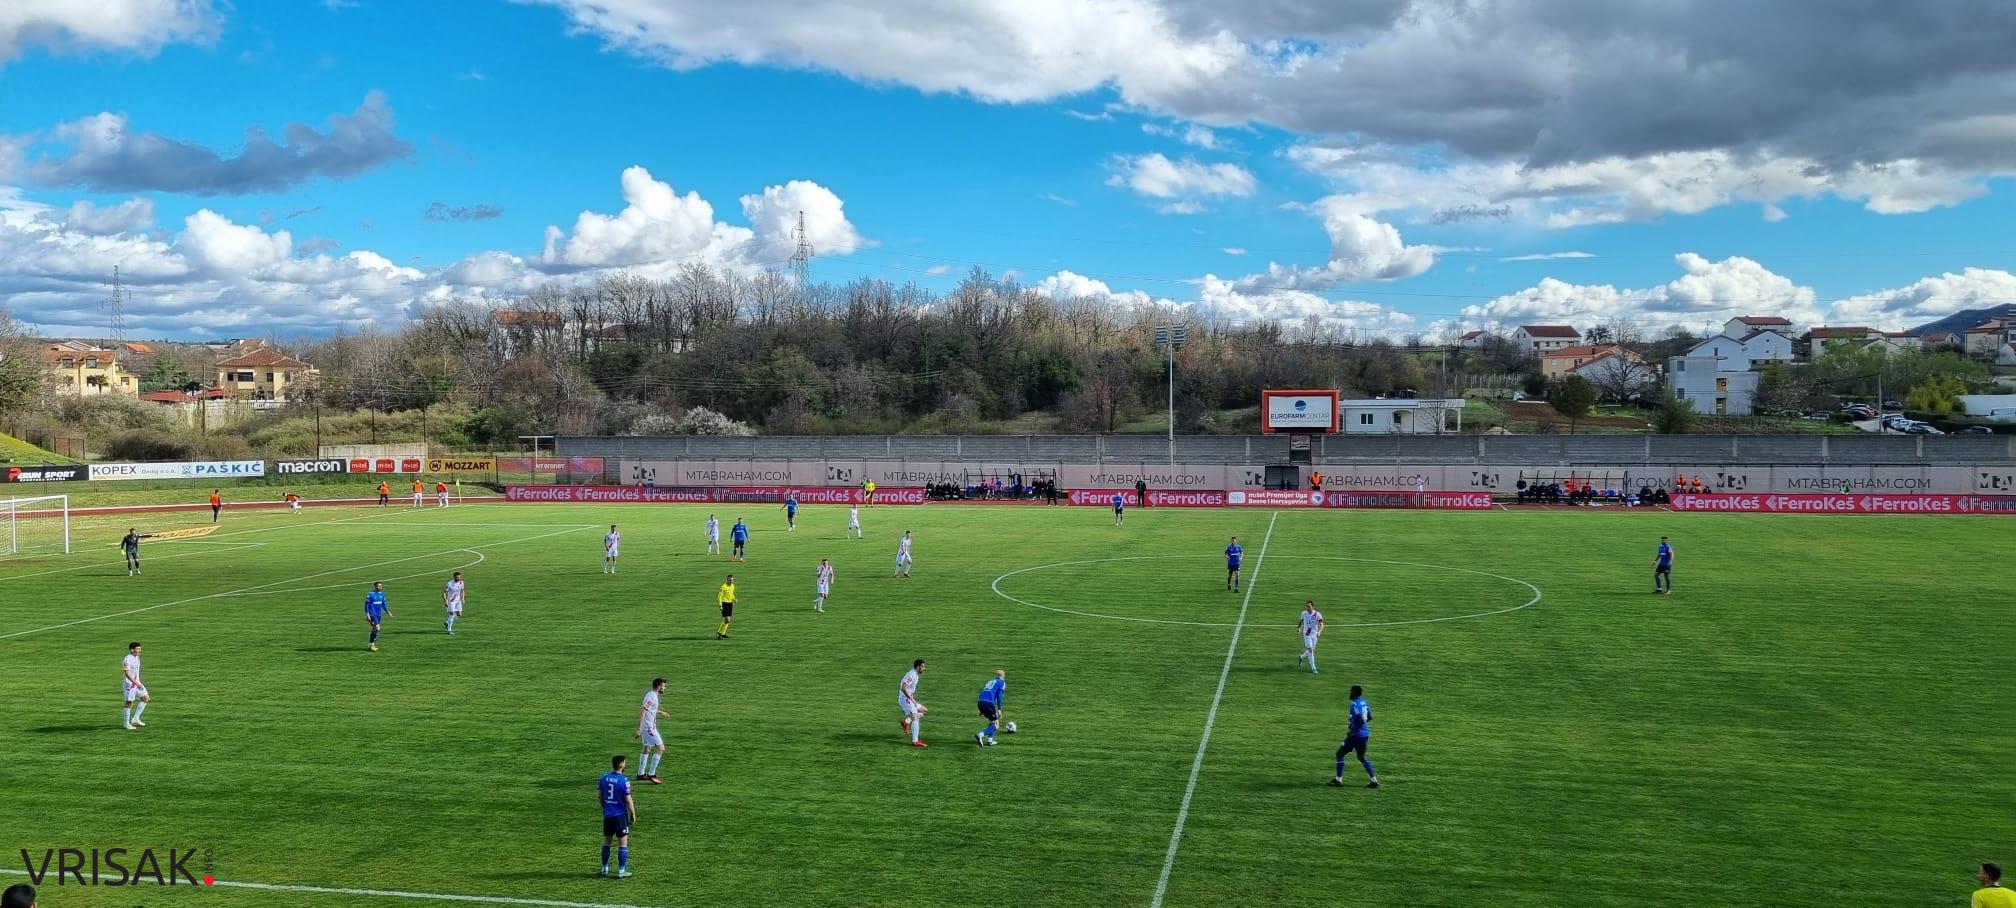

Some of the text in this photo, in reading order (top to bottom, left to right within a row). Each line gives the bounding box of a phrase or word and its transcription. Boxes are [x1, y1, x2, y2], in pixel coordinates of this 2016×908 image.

[92, 466, 137, 475] KOPEX
[278, 461, 340, 473] macron
[444, 462, 491, 470] MOZZART
[686, 471, 792, 481] MTABRAHAM.COM
[516, 488, 571, 499] FerroKeš
[584, 488, 640, 500] FerroKeš
[1685, 495, 1760, 509] FerroKeš
[1778, 496, 1855, 510] FerroKeš
[1872, 497, 1951, 511] FerroKeš
[607, 783, 614, 800] 3
